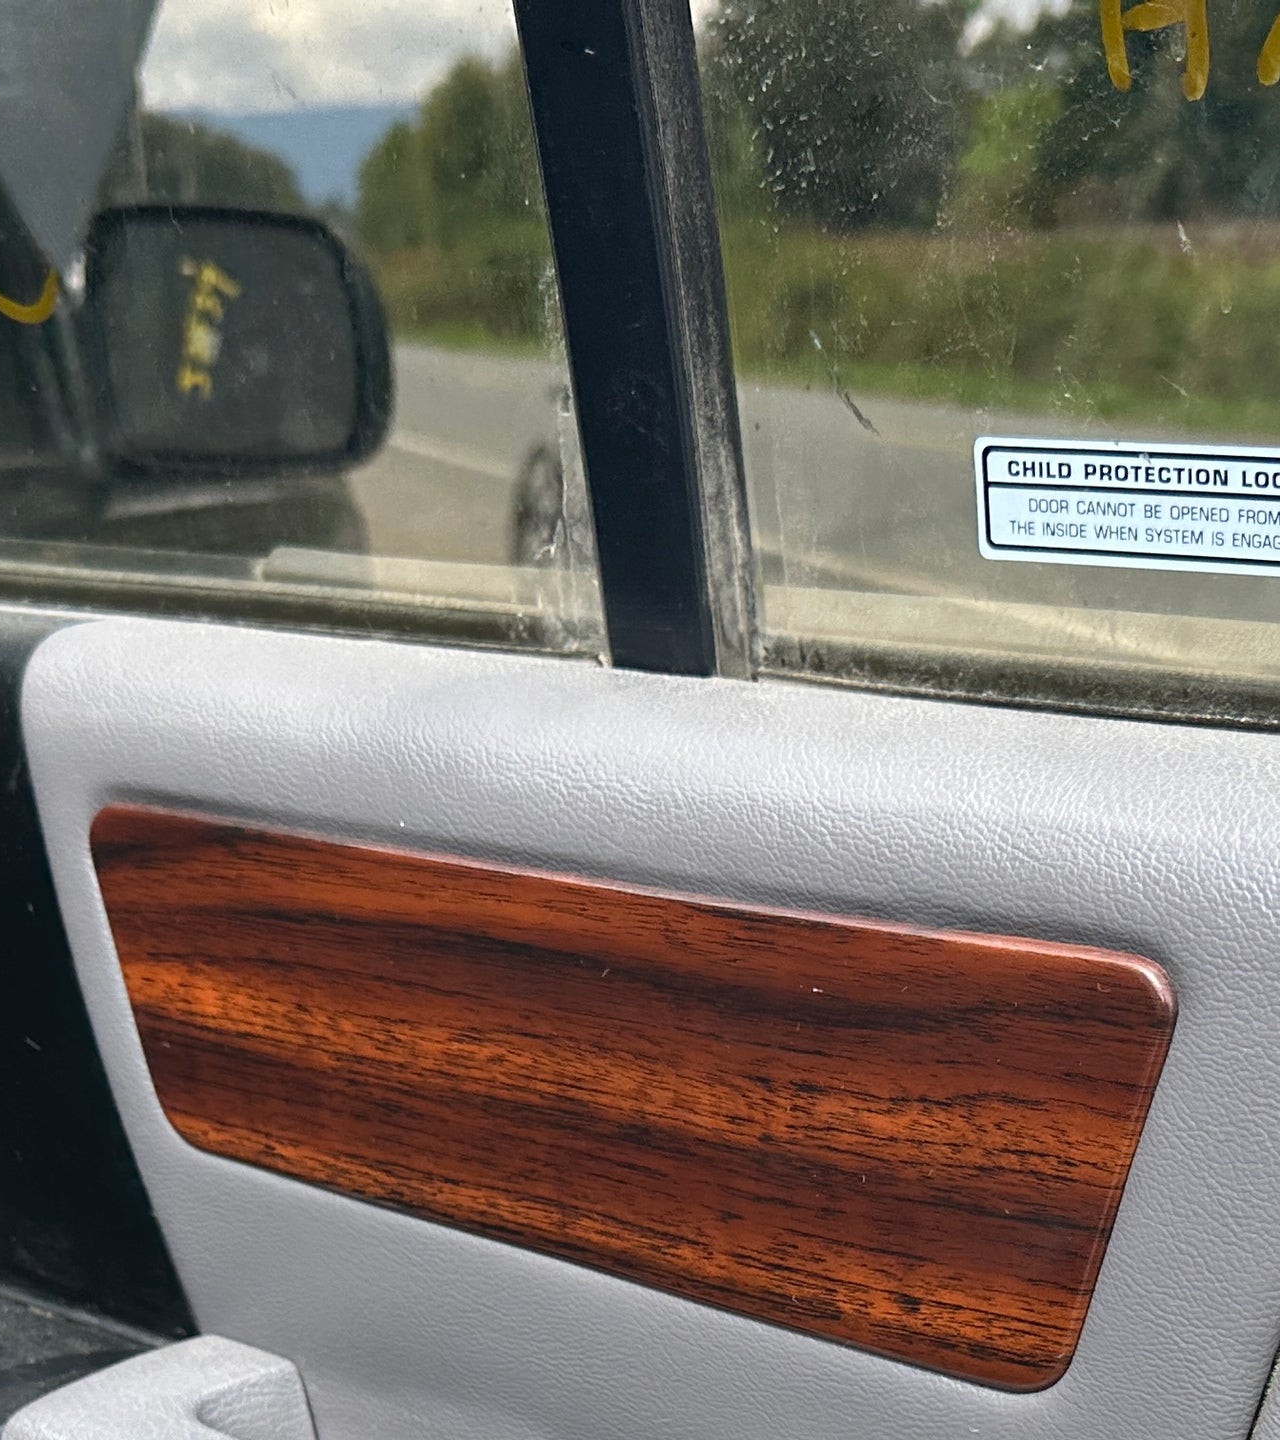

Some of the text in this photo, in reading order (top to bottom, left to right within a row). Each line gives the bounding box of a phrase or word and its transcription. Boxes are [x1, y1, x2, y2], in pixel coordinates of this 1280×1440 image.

[1007, 460, 1072, 479] CHILD
[1084, 464, 1229, 487] PROTECTION
[1028, 498, 1069, 515] DOOR
[1076, 501, 1136, 518] CANNOT
[1143, 504, 1163, 520] BE
[1170, 506, 1230, 523] OPENED
[1009, 520, 1036, 537] THE
[1042, 522, 1088, 539] INSIDE
[1094, 525, 1138, 542] WHEN
[1145, 528, 1204, 545] SYSTEM
[1211, 532, 1224, 547] IS
